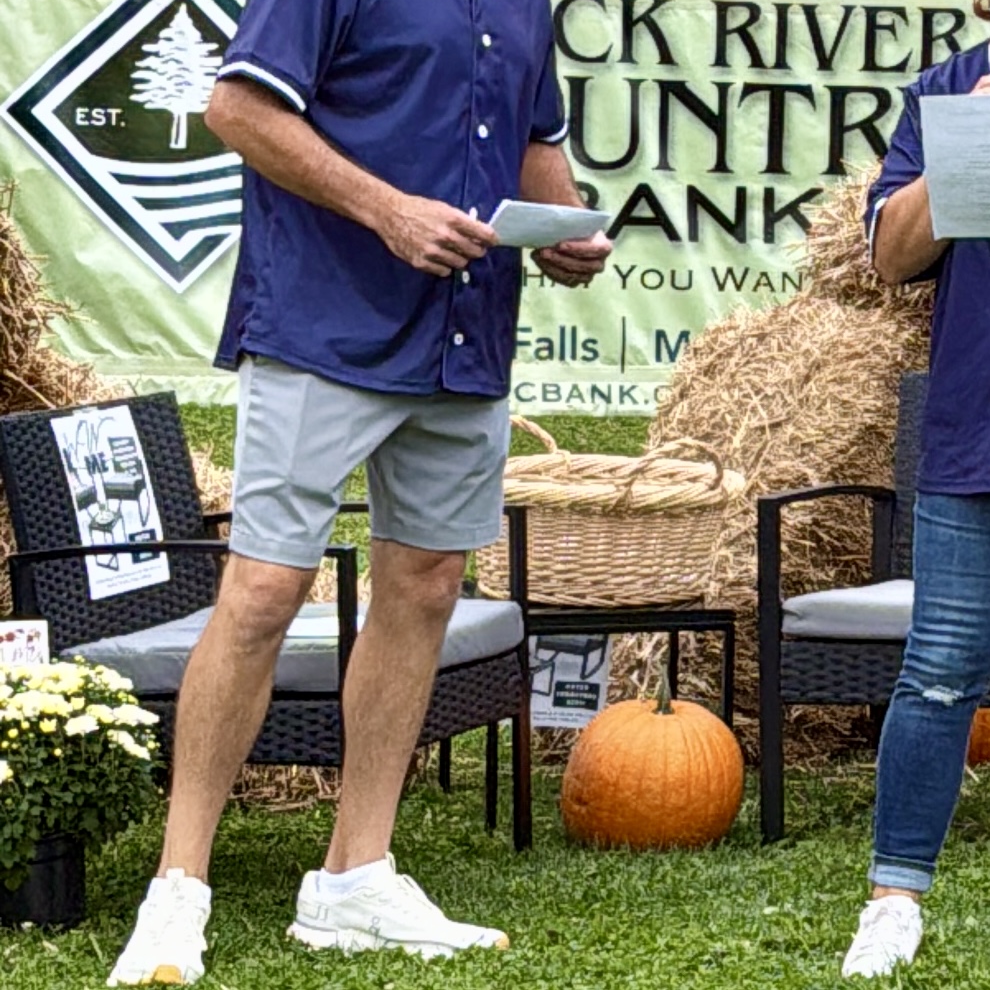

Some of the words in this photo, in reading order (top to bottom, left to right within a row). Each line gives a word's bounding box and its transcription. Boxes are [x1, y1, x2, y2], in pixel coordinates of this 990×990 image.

[710, 0, 967, 74] RIVER
[75, 107, 125, 126] EST.
[564, 75, 908, 176] UNTR
[513, 325, 599, 362] Falls
